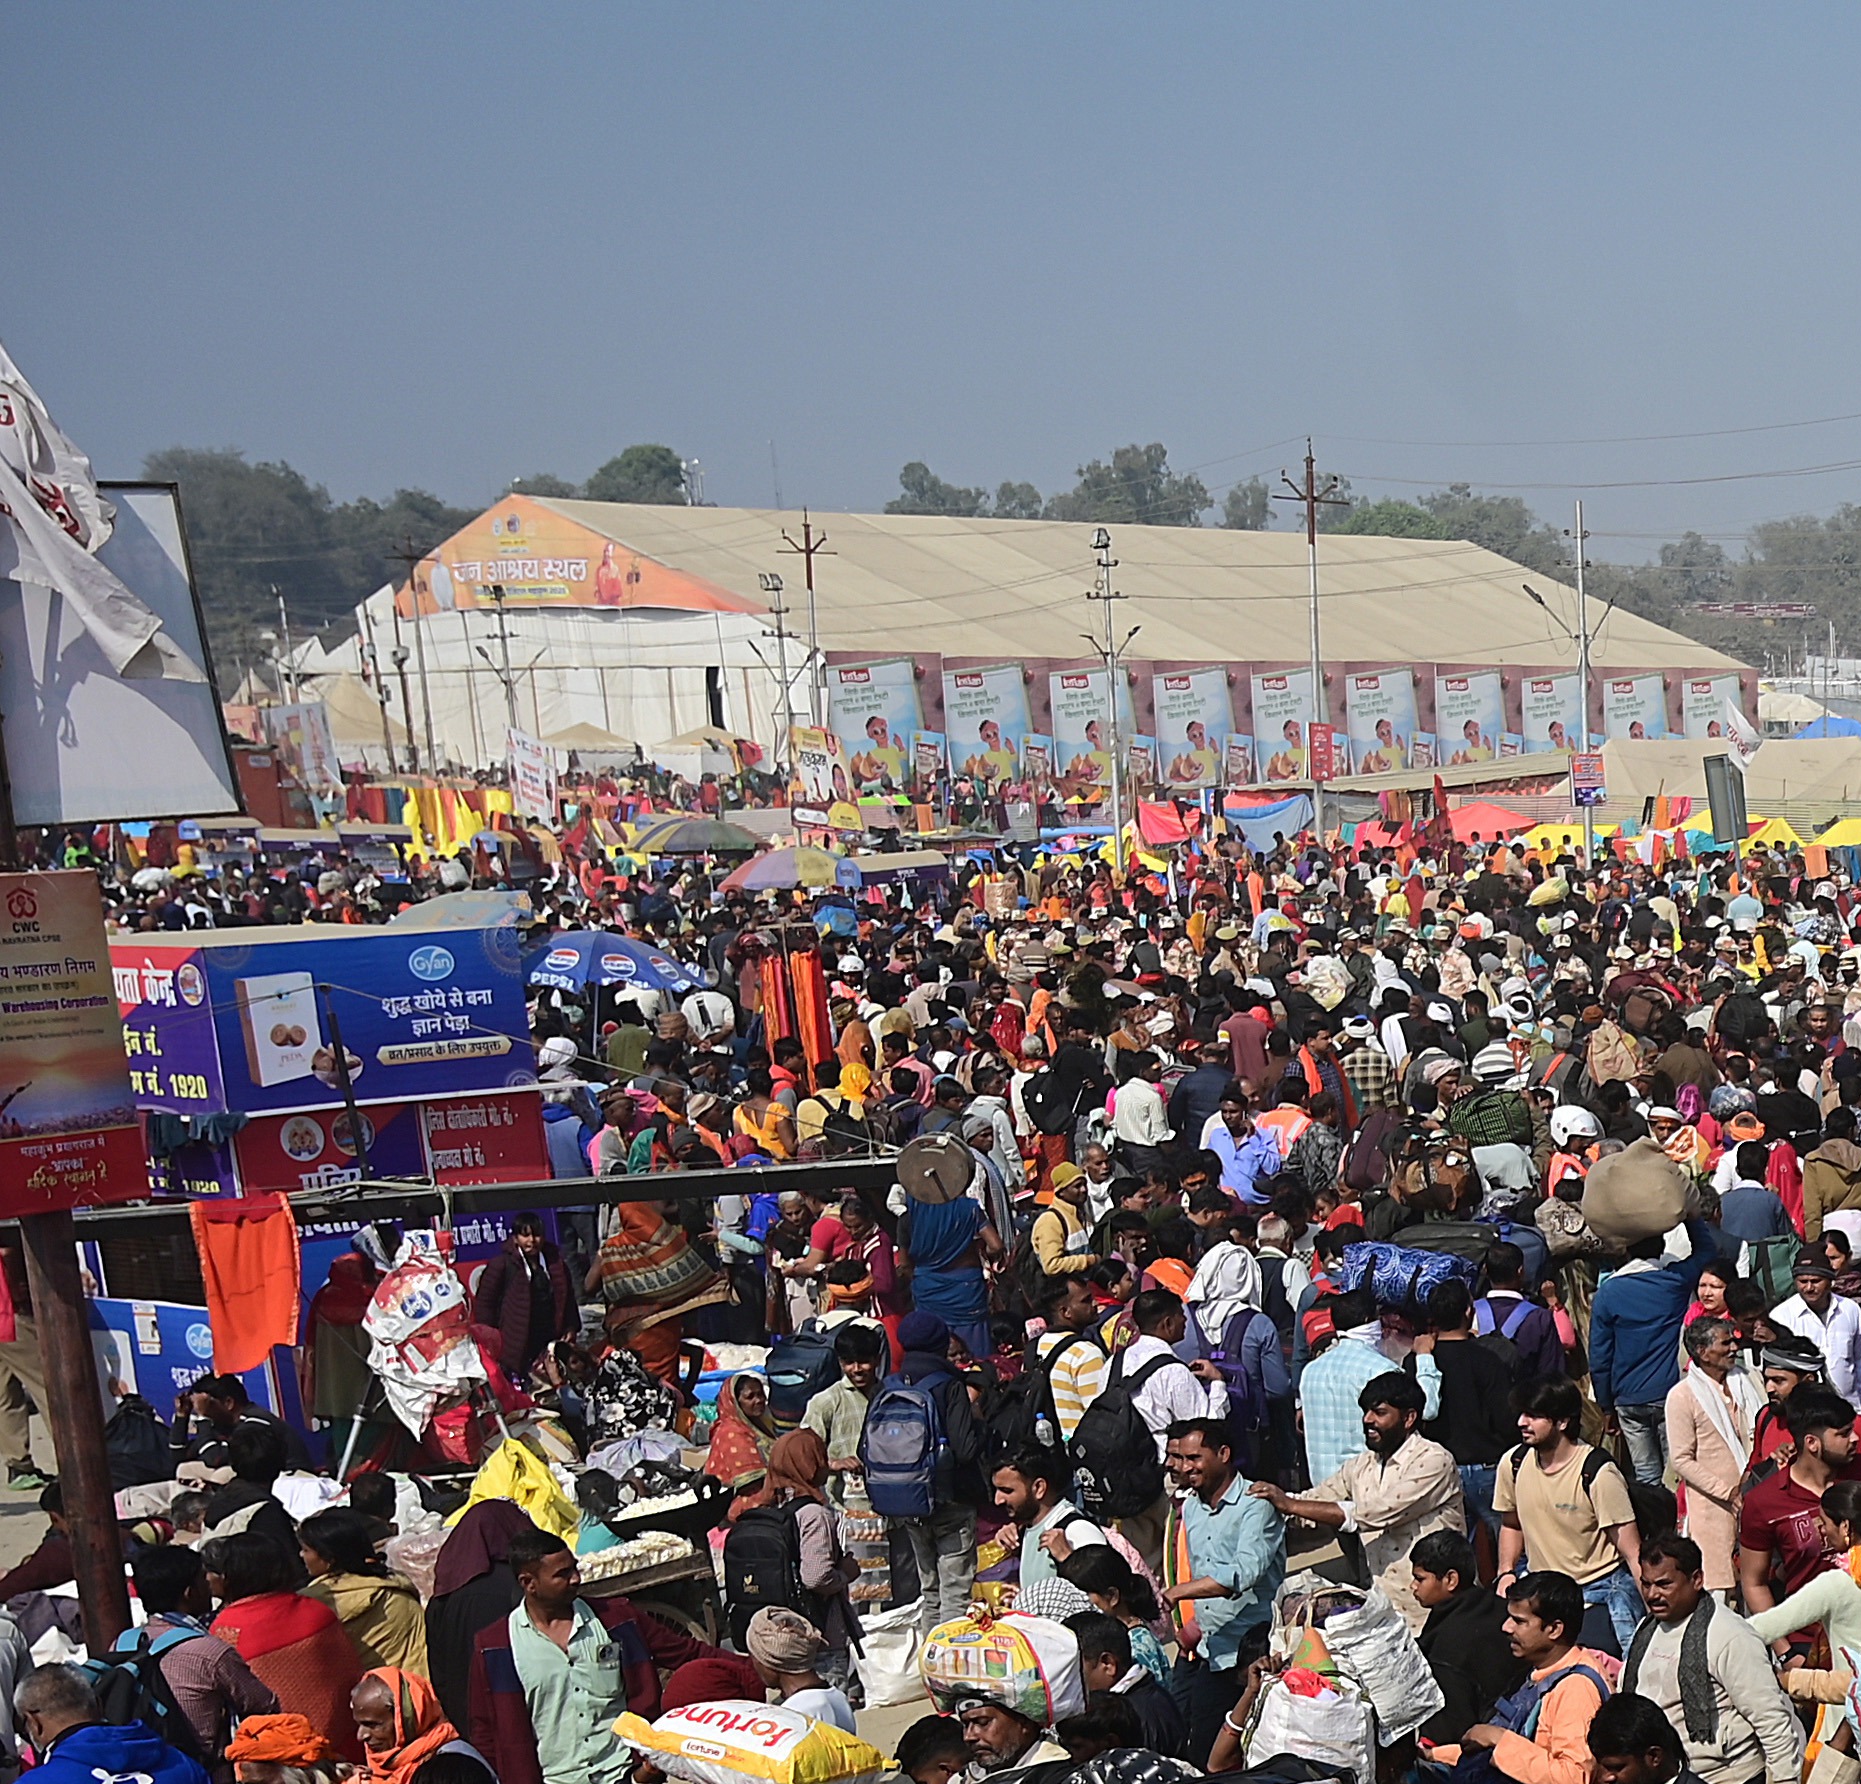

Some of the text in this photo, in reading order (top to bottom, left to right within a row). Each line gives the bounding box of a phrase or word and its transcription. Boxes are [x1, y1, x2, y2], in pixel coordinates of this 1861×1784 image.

[13, 921, 40, 933] CWC
[13, 962, 61, 979] भण्डारण
[65, 957, 97, 974] निगम
[413, 955, 452, 975] Gyan
[529, 972, 574, 988] PEPSI
[3, 995, 109, 1014] Warehousing Corporation
[382, 989, 493, 1019] शुद्ध खोये से बना
[411, 1013, 470, 1036] ज्ञान पेड़ा
[169, 1073, 208, 1100] 1920
[52, 1158, 84, 1171] आपका
[667, 1706, 793, 1747] fortune
[686, 1741, 721, 1757] fortune
